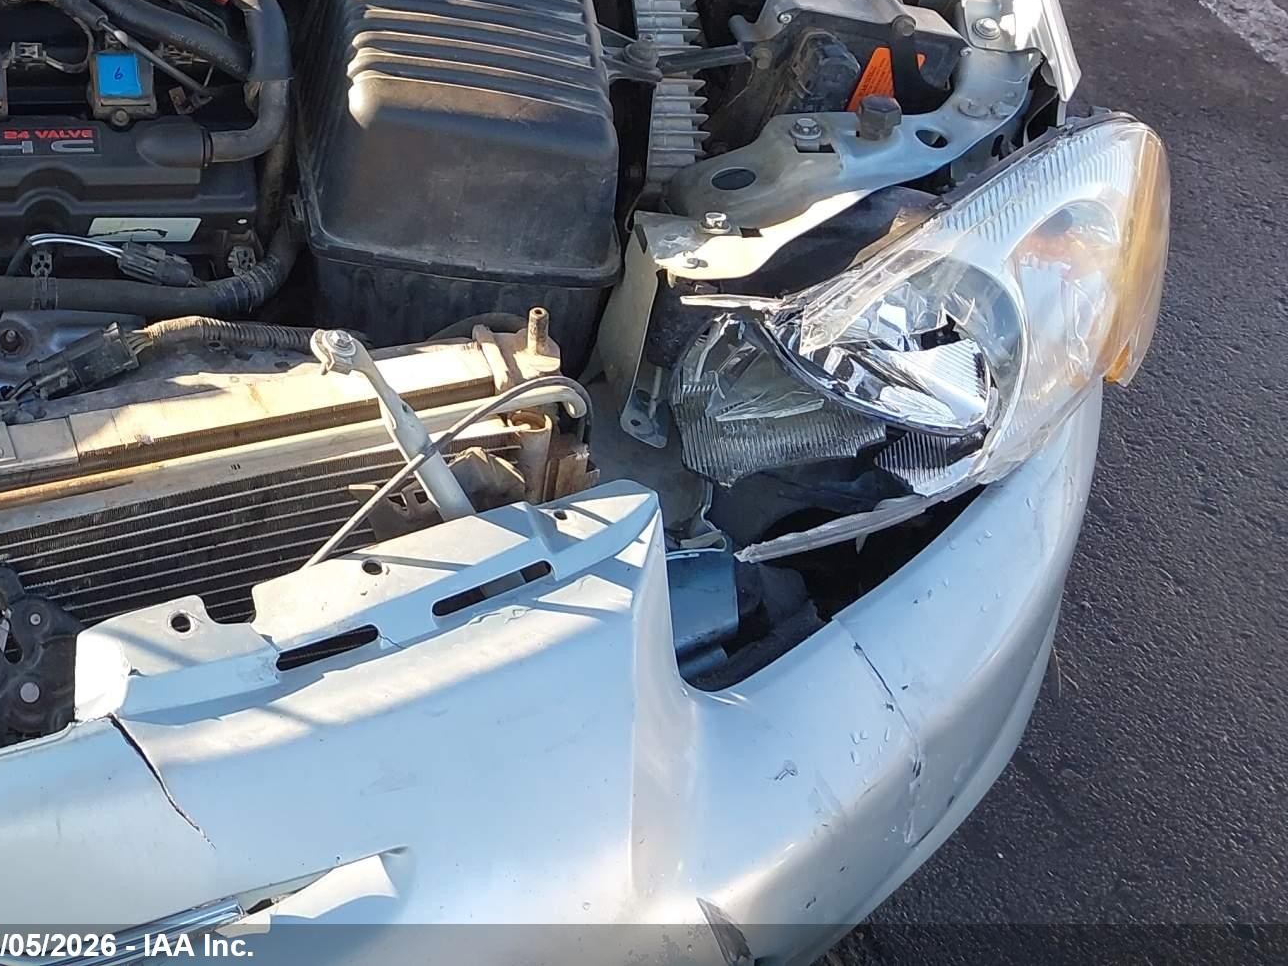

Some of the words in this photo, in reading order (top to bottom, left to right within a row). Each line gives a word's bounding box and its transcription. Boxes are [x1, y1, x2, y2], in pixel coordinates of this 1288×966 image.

[114, 67, 123, 80] 6
[3, 130, 30, 139] 24
[35, 129, 93, 139] VALVE
